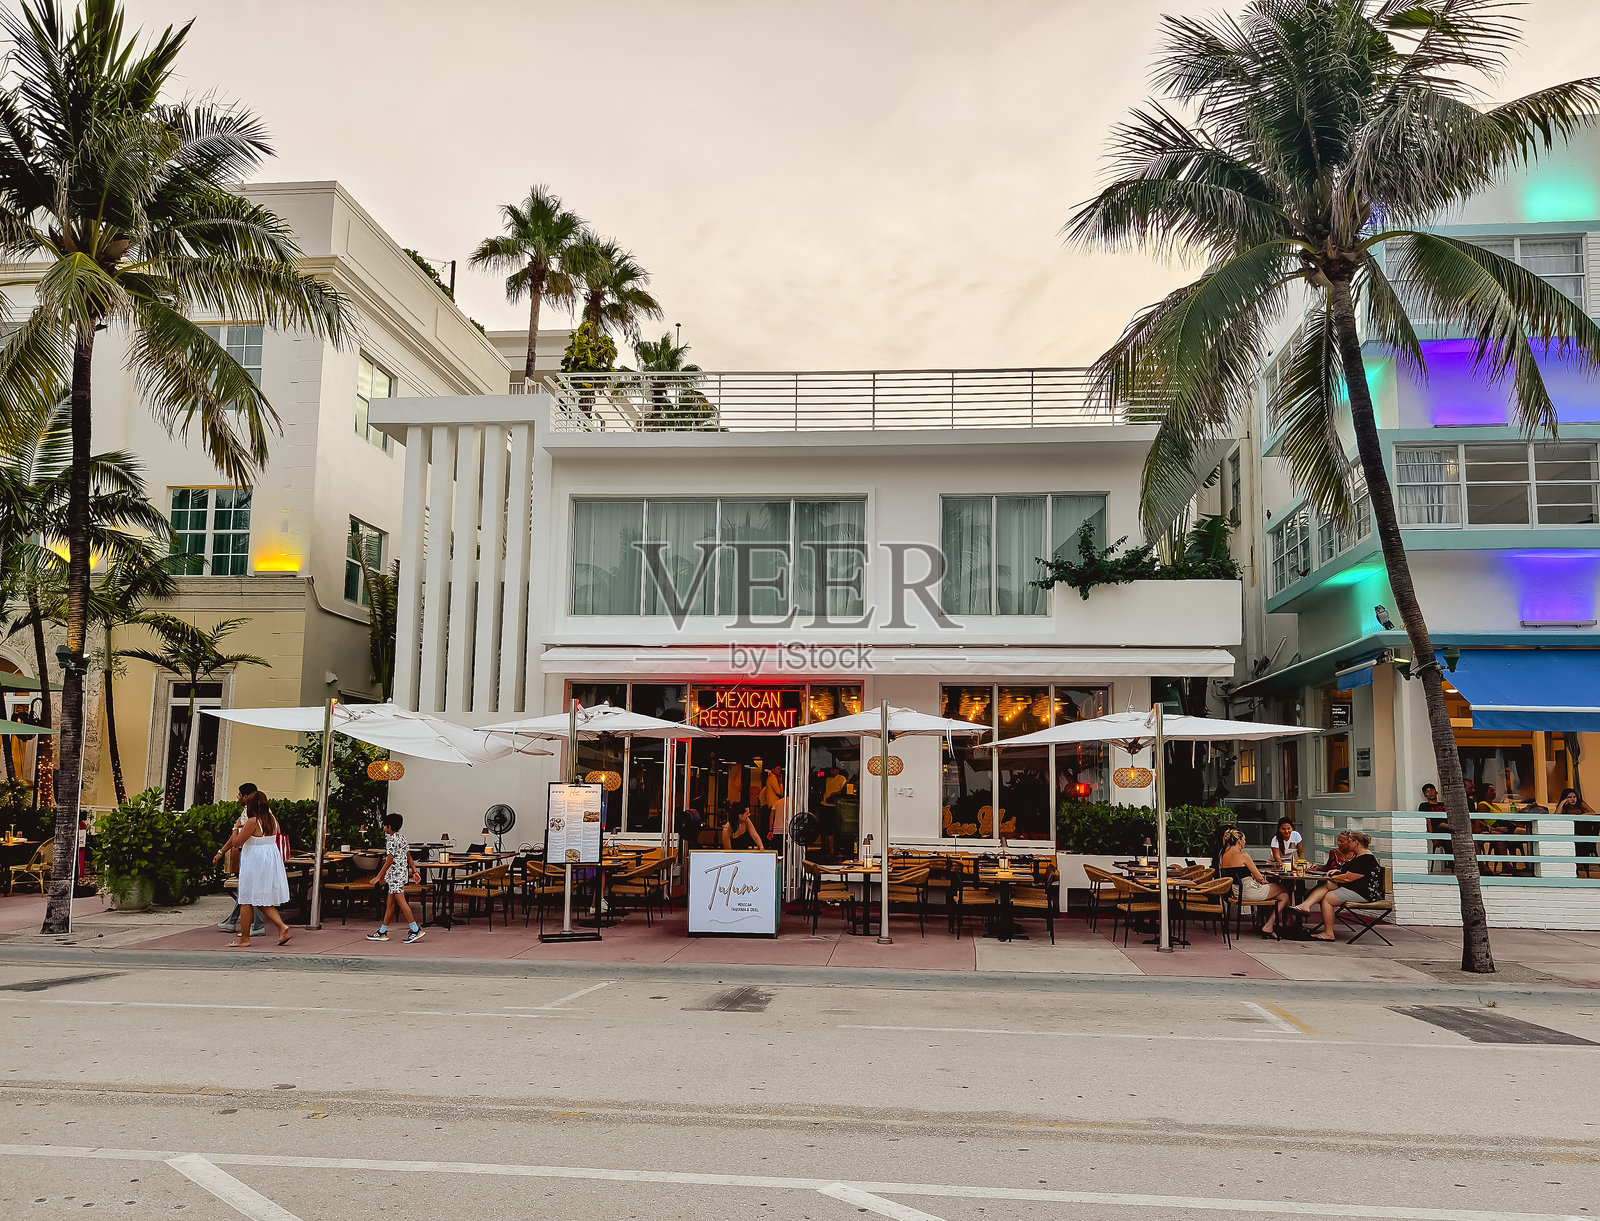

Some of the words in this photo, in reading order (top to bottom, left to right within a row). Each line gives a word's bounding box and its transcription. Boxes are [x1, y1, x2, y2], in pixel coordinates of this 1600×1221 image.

[716, 691, 780, 709] MEXICAN
[699, 709, 797, 728] RESTAURANT
[704, 859, 760, 911] Tulum
